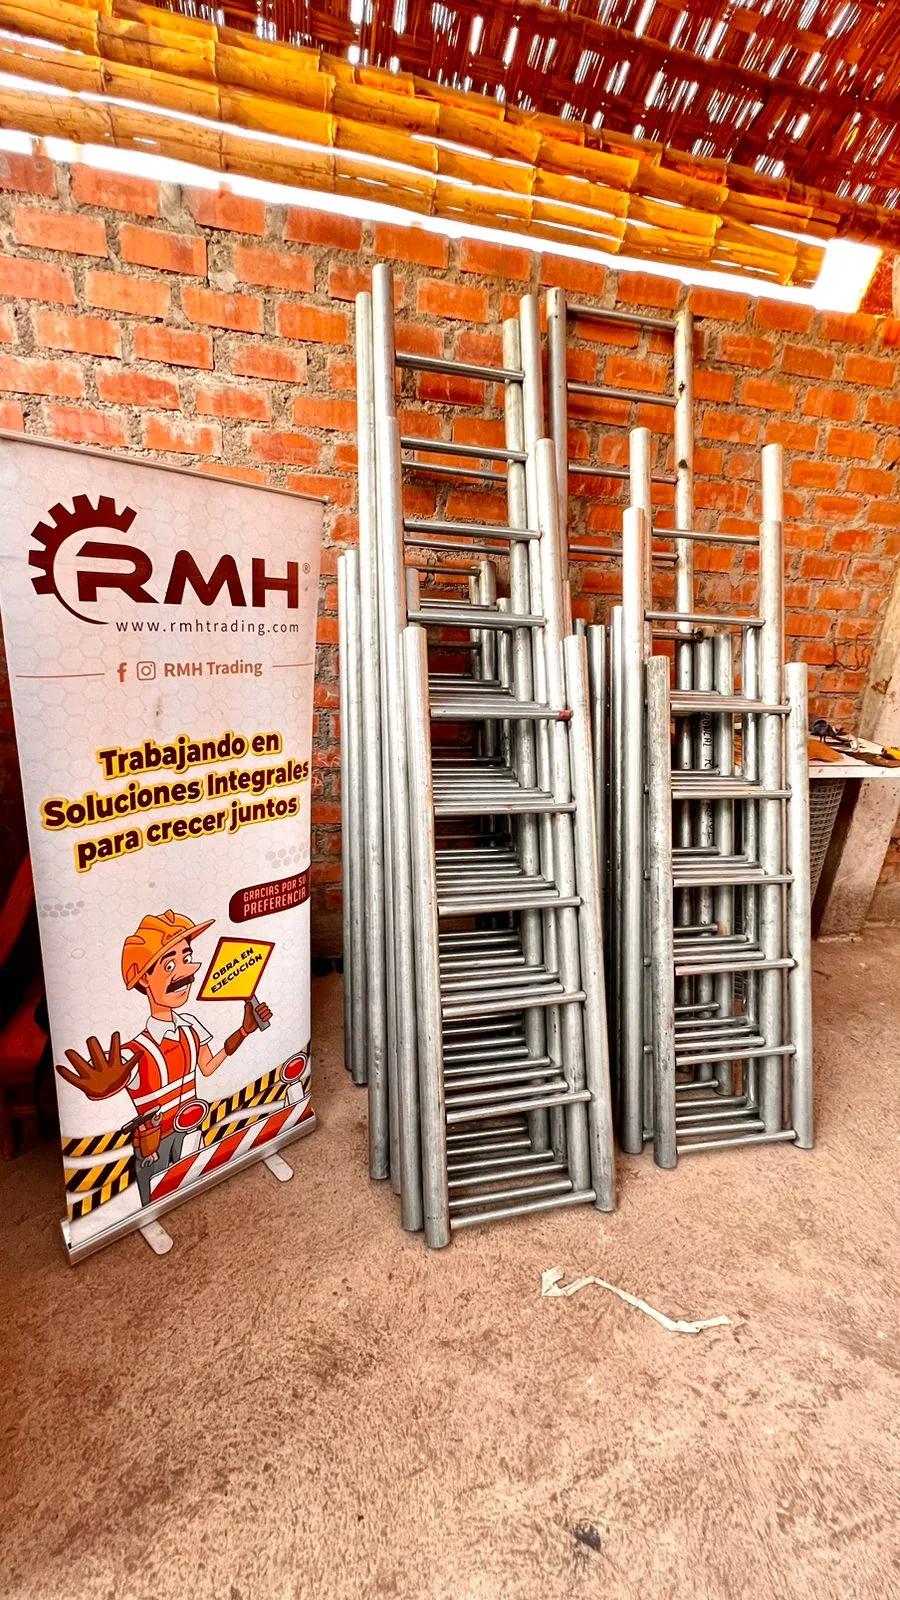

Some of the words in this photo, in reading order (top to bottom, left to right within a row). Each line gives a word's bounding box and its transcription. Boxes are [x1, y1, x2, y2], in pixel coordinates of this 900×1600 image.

[75, 541, 299, 609] RMH
[116, 619, 299, 636] www.rmhtrading.com
[164, 663, 202, 677] RMH
[206, 660, 263, 678] Trading
[100, 733, 245, 776] Trabajando
[252, 733, 279, 752] en
[43, 782, 200, 827] Soluciones
[207, 760, 309, 797] Integrales
[77, 828, 139, 869] para
[146, 810, 226, 843] crecer
[229, 796, 297, 831] juntos
[243, 886, 280, 902] GRACIAS
[282, 879, 297, 893] POR
[298, 875, 307, 887] SU
[244, 887, 306, 917] PREFERENCIA
[210, 953, 263, 994] EJECUCIÓN
[212, 958, 240, 980] OBRA
[240, 947, 254, 960] EN
